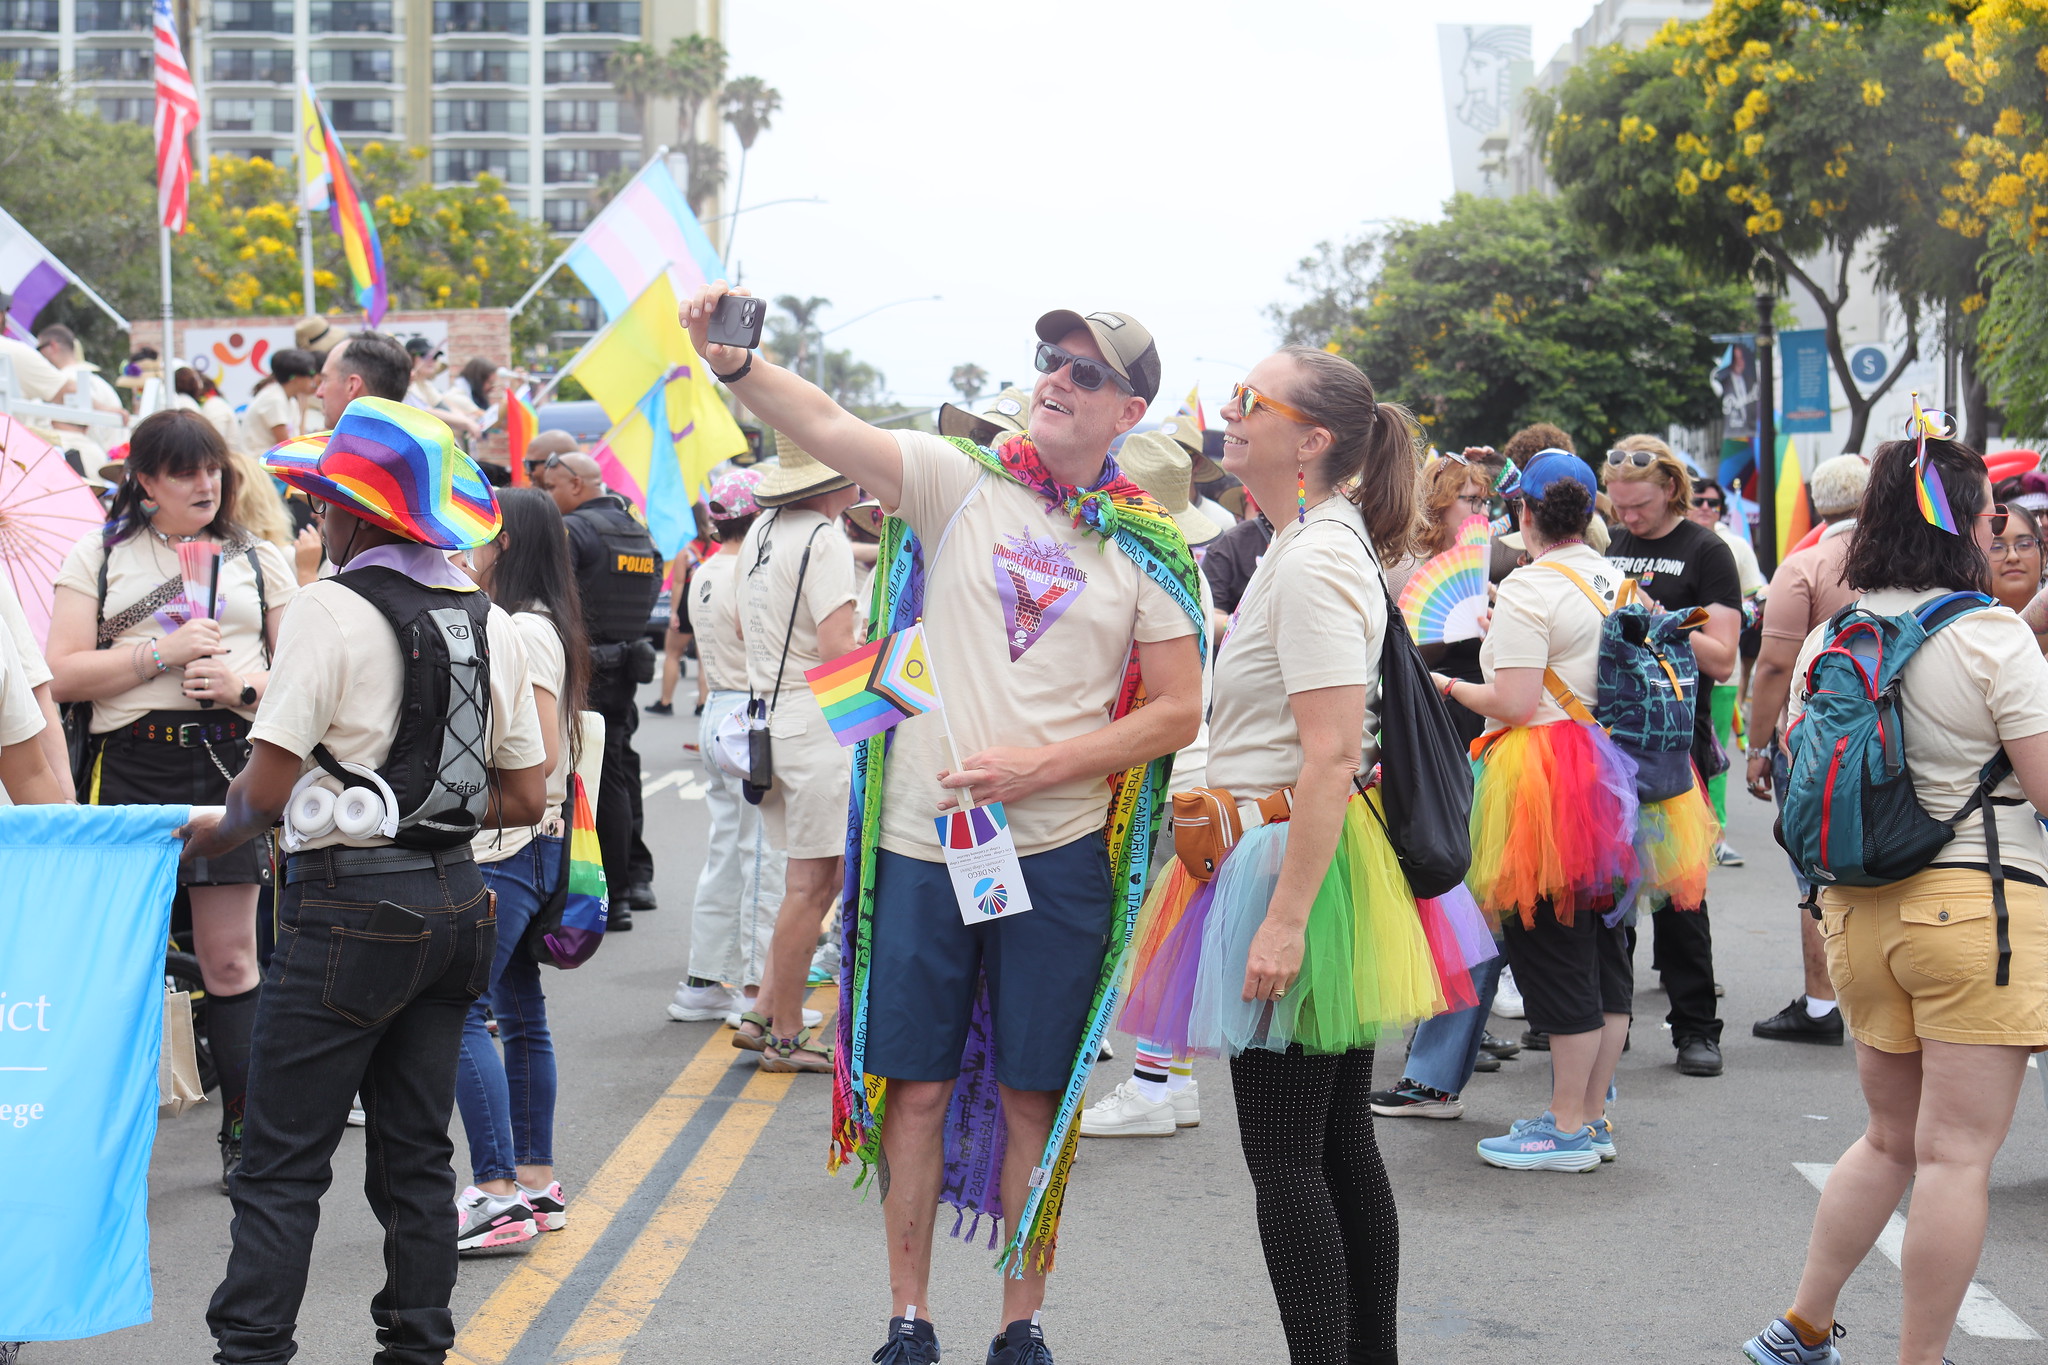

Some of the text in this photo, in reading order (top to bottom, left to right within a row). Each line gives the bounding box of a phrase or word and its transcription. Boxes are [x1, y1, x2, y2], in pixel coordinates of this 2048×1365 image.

[1862, 354, 1876, 375] S
[617, 554, 655, 574] POLICE
[992, 542, 1088, 584] UNBREAKABLE PRIDE
[997, 556, 1079, 592] UNSHAKEABLE POWER
[447, 780, 481, 794] Zéfal
[967, 866, 1001, 879] SAN DIEGO
[1520, 1139, 1556, 1152] HOKA
